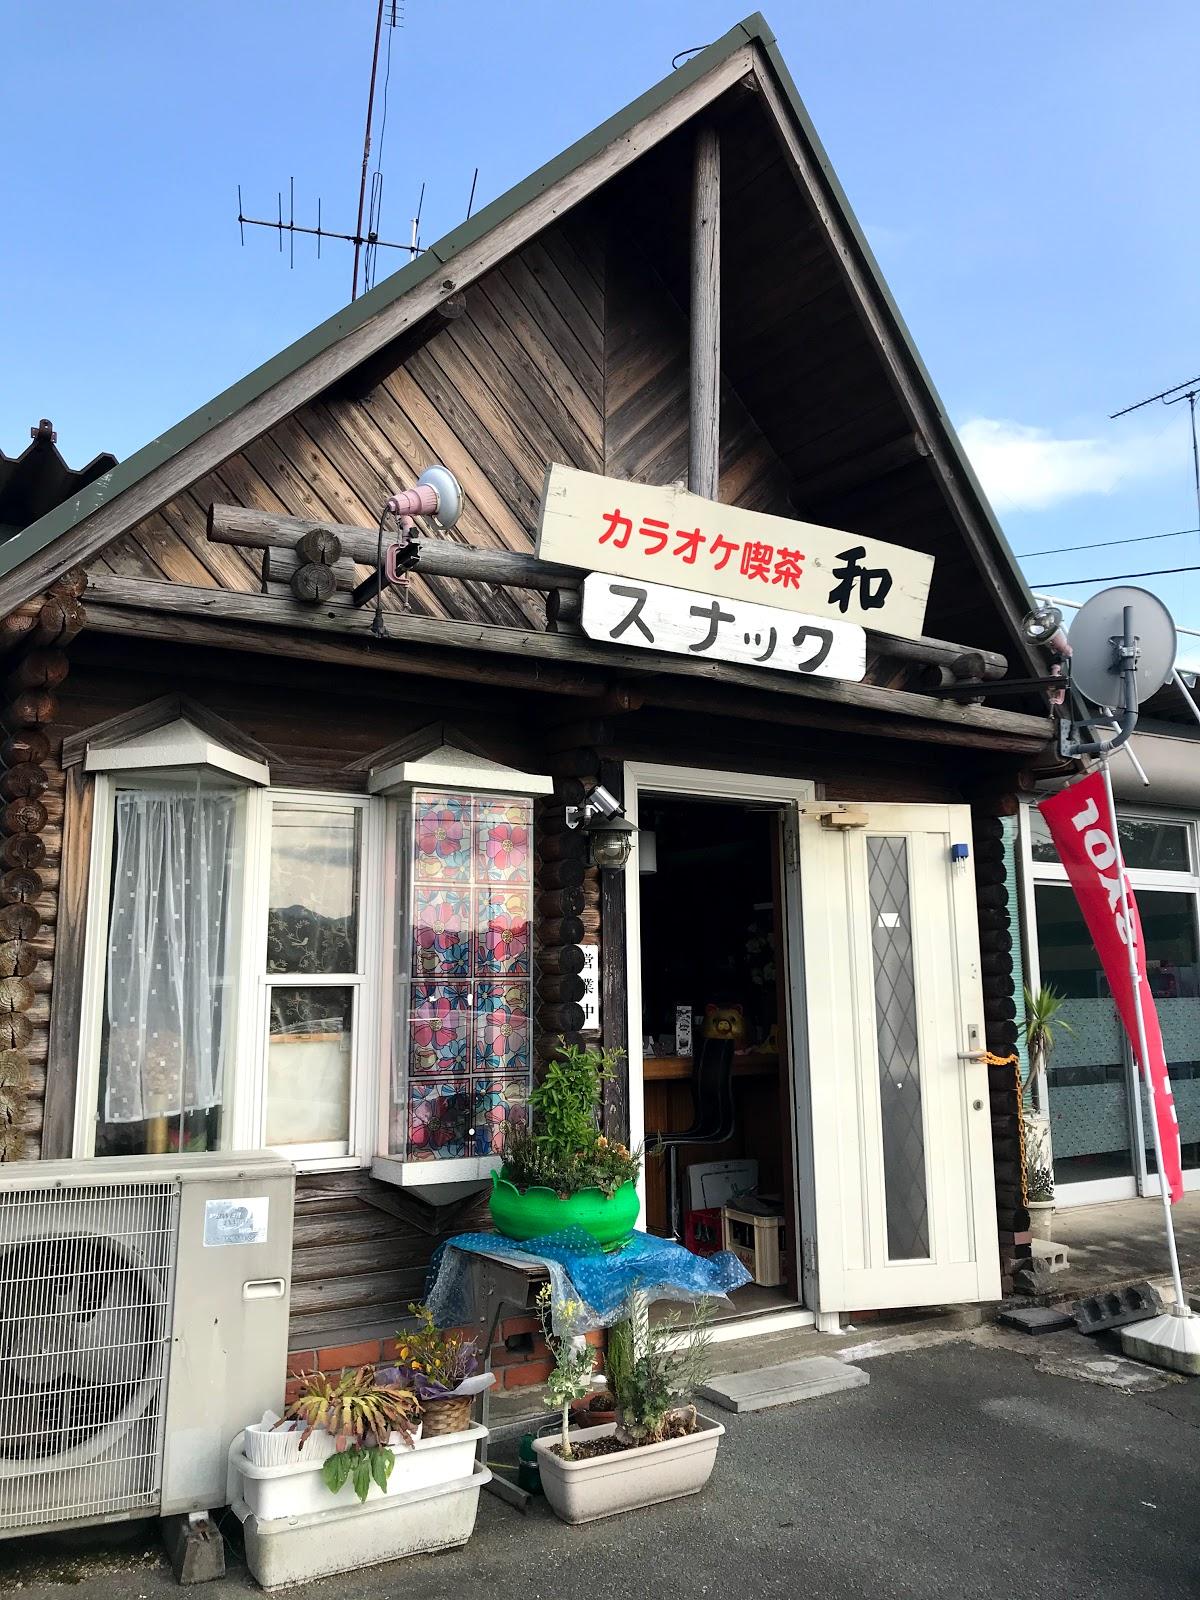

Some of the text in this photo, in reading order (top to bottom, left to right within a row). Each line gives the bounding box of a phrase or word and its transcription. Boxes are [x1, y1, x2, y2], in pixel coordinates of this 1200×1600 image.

[598, 508, 894, 613] カラオケ喫茶 和
[608, 583, 834, 673] スナック
